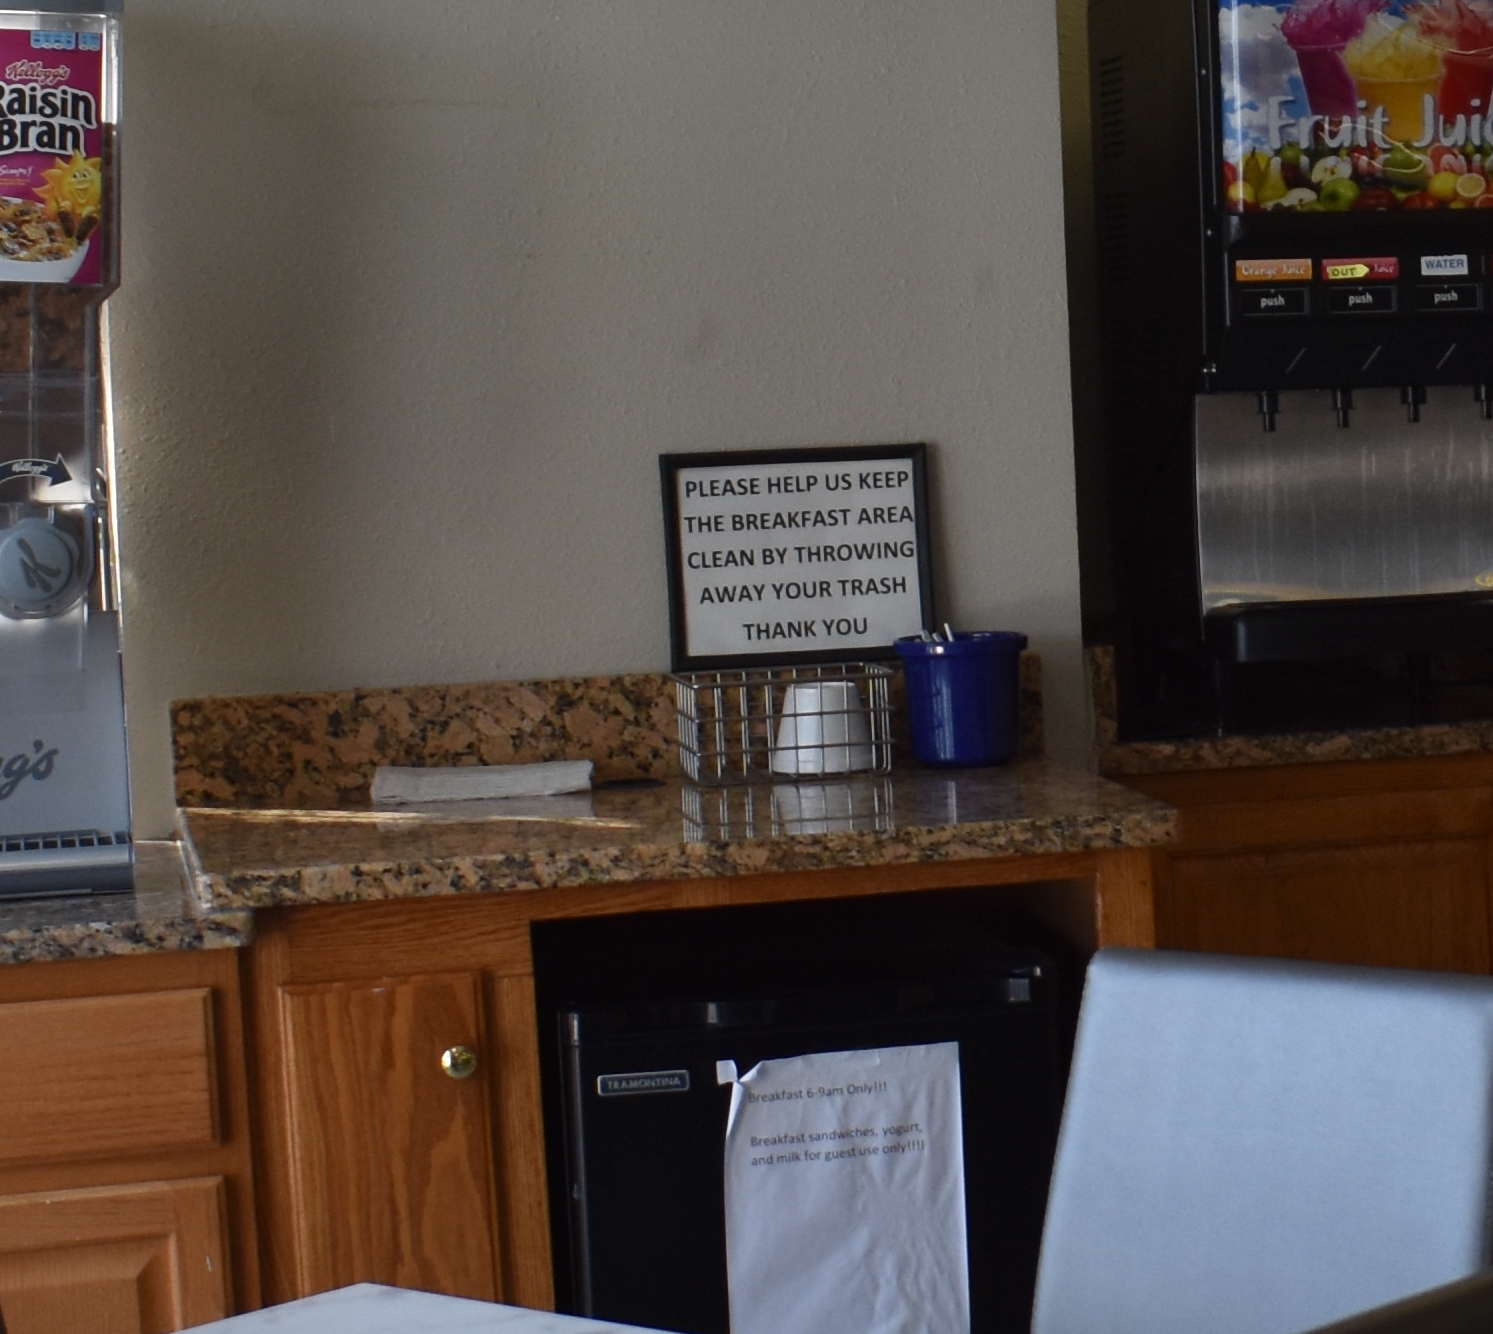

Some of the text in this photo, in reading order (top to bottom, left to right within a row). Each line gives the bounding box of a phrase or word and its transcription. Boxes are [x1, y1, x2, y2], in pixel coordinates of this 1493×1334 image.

[5, 59, 70, 85] Kellogg's
[1267, 95, 1391, 149] Fruit
[1242, 263, 1306, 279] Orange Juice
[1331, 267, 1357, 277] OUT
[1424, 258, 1465, 270] WATER
[1260, 293, 1286, 308] push
[1348, 290, 1373, 306] push
[1434, 288, 1458, 304] push
[685, 471, 909, 498] PLEASE HELP US KEEP
[684, 506, 914, 533] THE BREAKFAST AREA
[687, 541, 915, 569] CLEAN BY THROWING
[699, 576, 907, 604] AWAY YOUR TRASH
[743, 617, 868, 641] THANK YOU
[607, 1075, 681, 1091] TRAMONTINA
[748, 1081, 887, 1103] Breakfast 6-9am Only!!!
[751, 1132, 805, 1147] Breakfast
[751, 1152, 774, 1166] and
[776, 1151, 801, 1164] milk
[804, 1149, 821, 1161] for
[824, 1147, 855, 1163] guest
[859, 1146, 878, 1157] use
